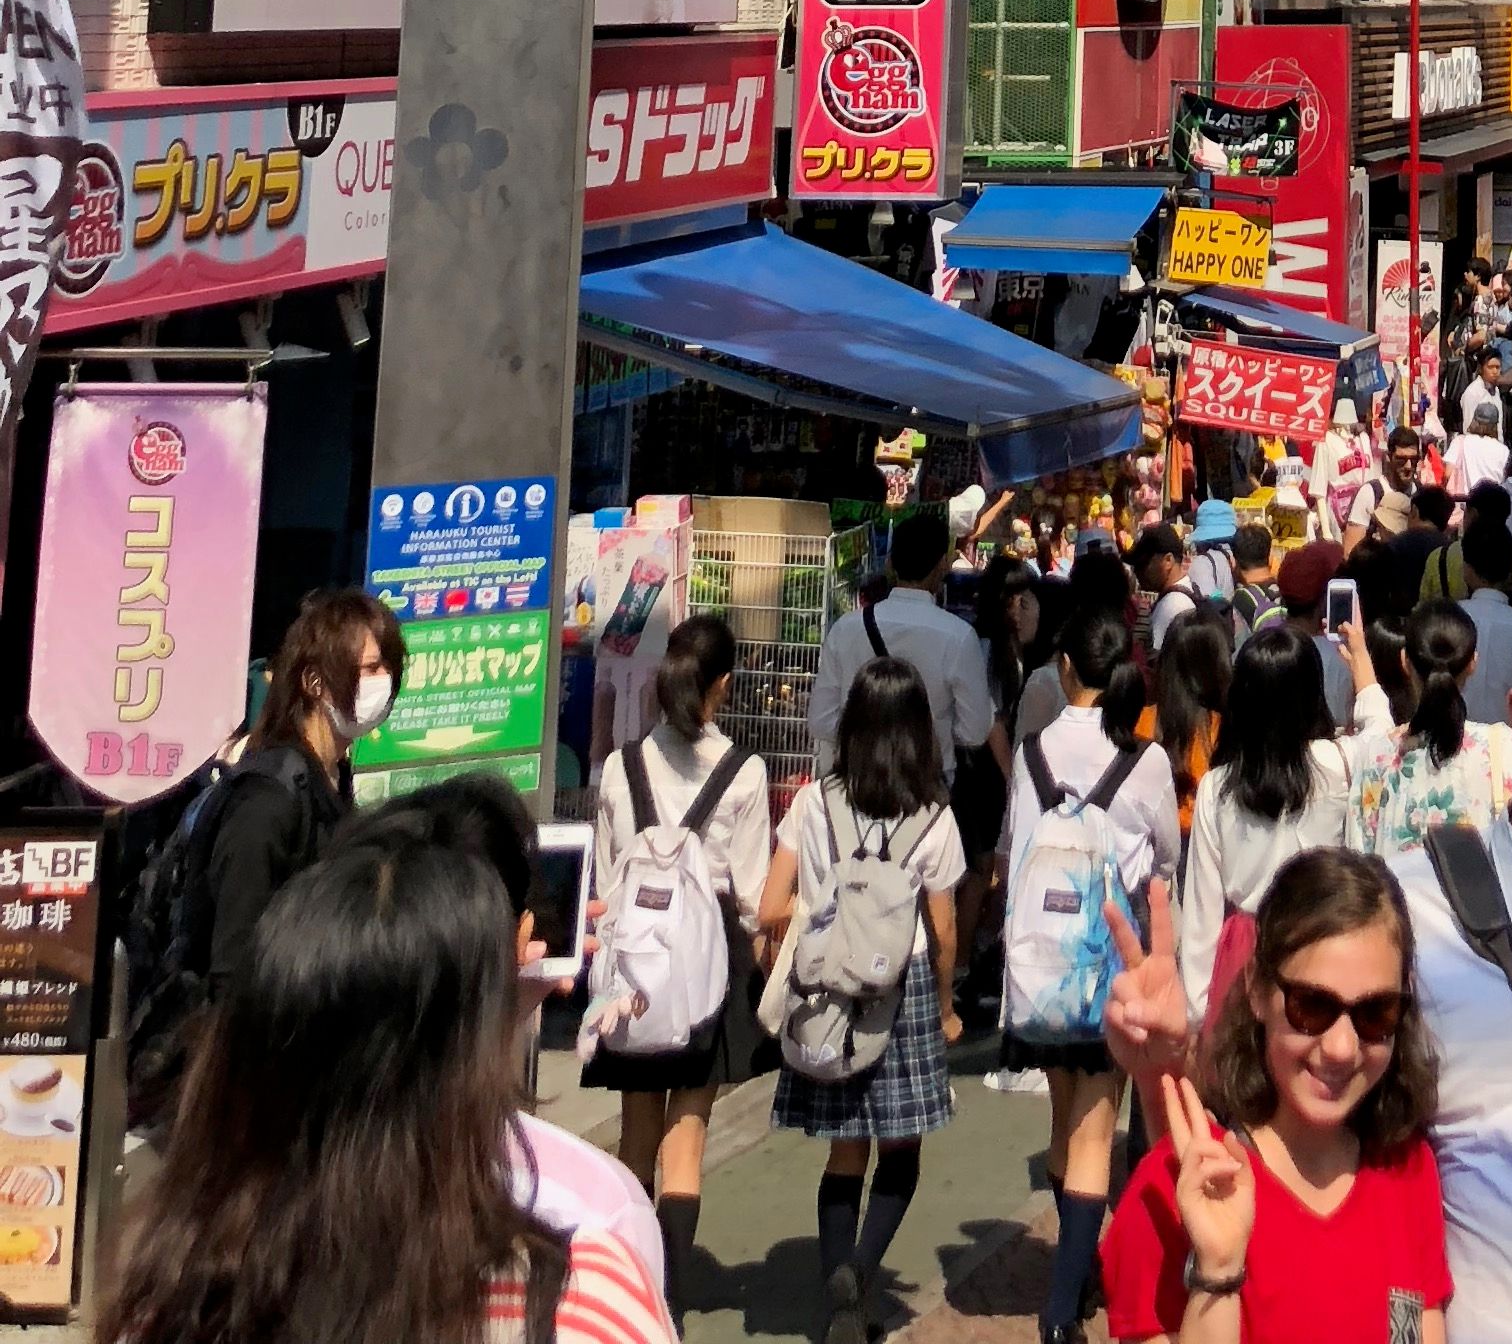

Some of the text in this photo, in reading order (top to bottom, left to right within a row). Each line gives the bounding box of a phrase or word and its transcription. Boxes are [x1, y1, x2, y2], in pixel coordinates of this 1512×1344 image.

[300, 103, 338, 141] B1F
[1205, 108, 1268, 130] LASER
[1274, 140, 1294, 156] 3F
[1177, 217, 1271, 248] ハッピーワン
[1173, 253, 1265, 281] HAPPY ONE
[1194, 346, 1332, 384] 原宿ハッピーワン
[1187, 367, 1331, 419] スクイーズ
[1184, 399, 1326, 434] SQUEEZE
[401, 534, 521, 554] INFORMATION CENTER
[410, 523, 516, 542] HARAJUKU TOURIST
[463, 576, 479, 587] TIC
[113, 495, 175, 724] コスプリ
[427, 691, 464, 702] STREET
[468, 686, 511, 698] OFFICIAL
[391, 710, 511, 731] PLEASE TAKE IT FREELY
[84, 730, 183, 778] B1F
[51, 847, 93, 877] BF
[1, 898, 72, 933] 珈琲
